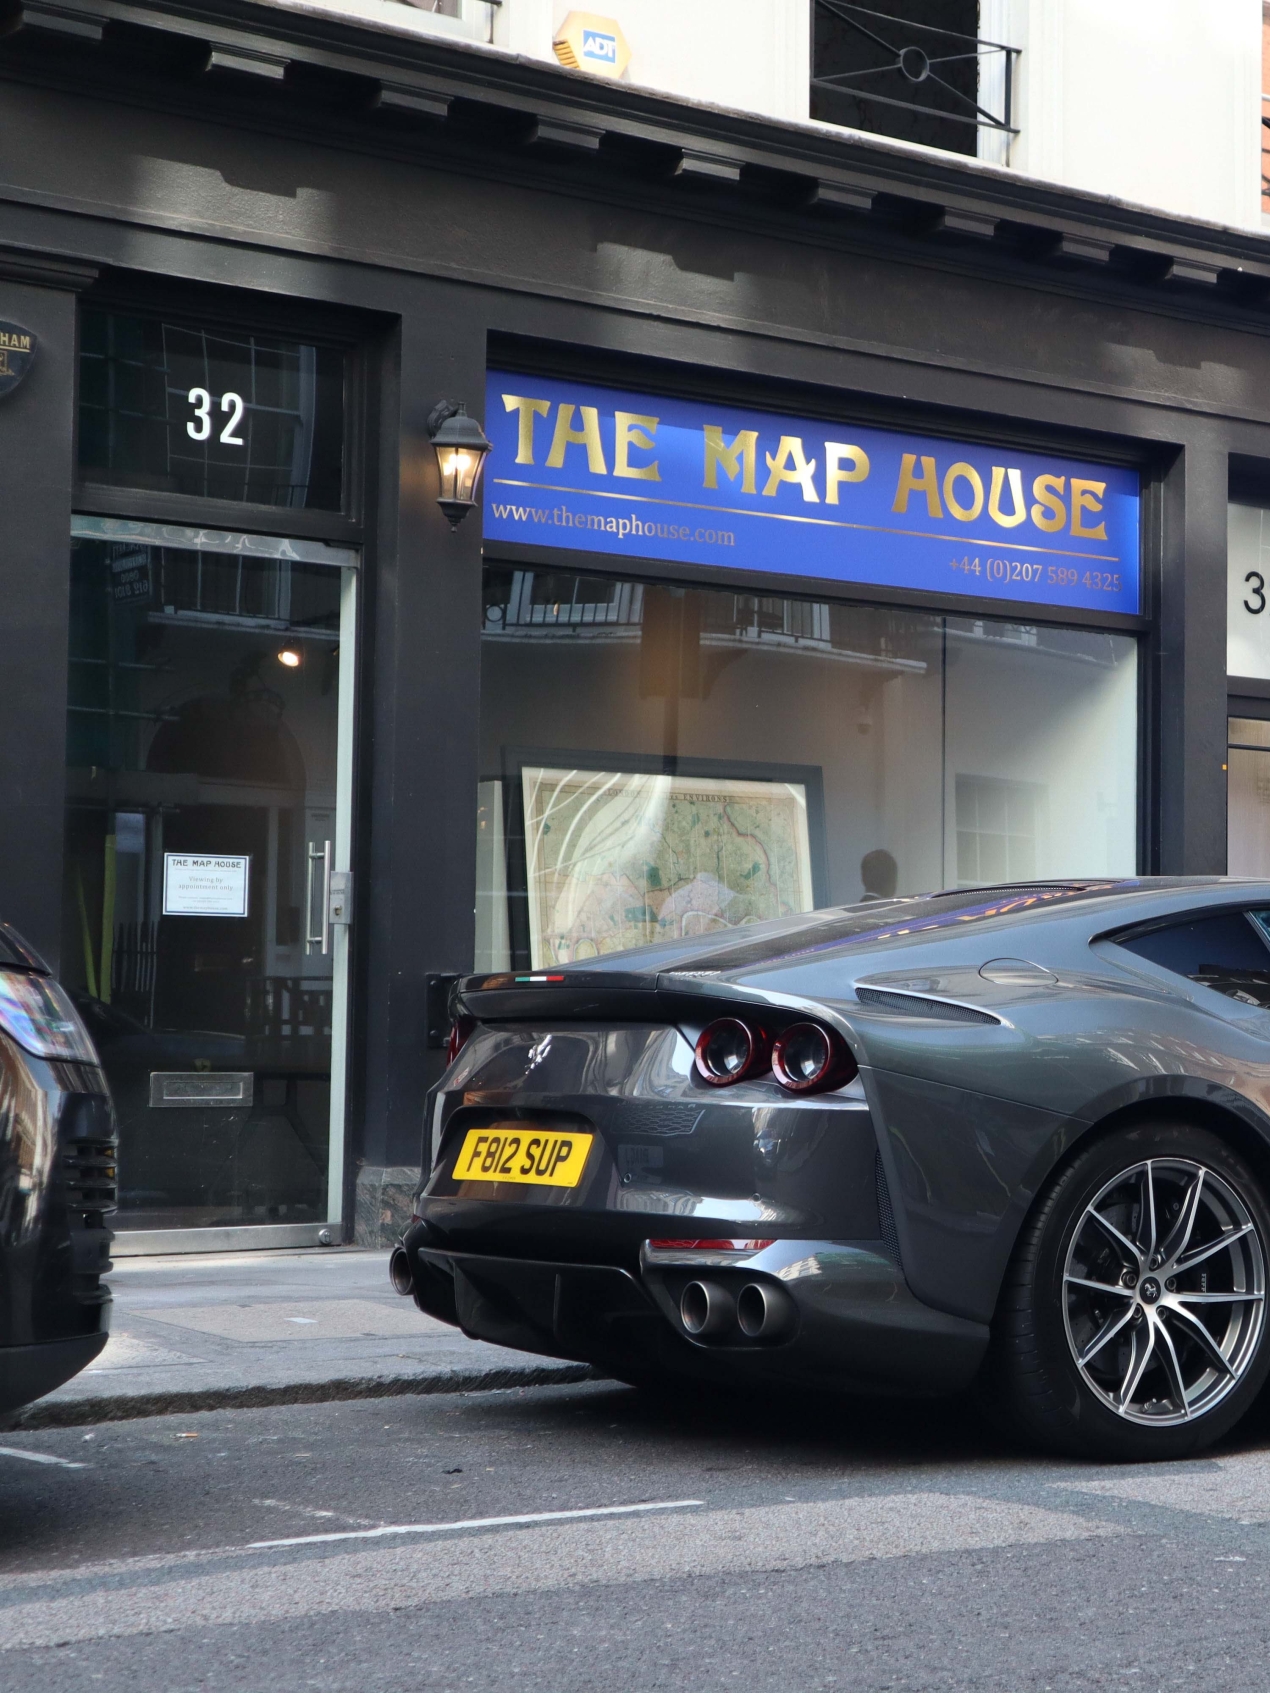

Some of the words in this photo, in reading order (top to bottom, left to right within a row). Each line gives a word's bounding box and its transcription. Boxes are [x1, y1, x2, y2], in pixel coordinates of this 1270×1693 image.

[583, 35, 616, 58] ADT
[186, 387, 244, 446] 32
[501, 393, 662, 482] THE
[702, 424, 870, 505] MAP
[891, 453, 1108, 540] HOUSE
[491, 502, 736, 547] www.themaphouse.com
[949, 556, 982, 576] +44
[1047, 566, 1078, 587] 589
[1081, 571, 1123, 592] 4325
[683, 793, 728, 803] ENVIRONS
[171, 858, 188, 867] THE
[192, 859, 212, 868] MAP
[213, 860, 242, 869] HOUSE
[466, 1136, 521, 1175] F812
[520, 1137, 573, 1178] SUP
